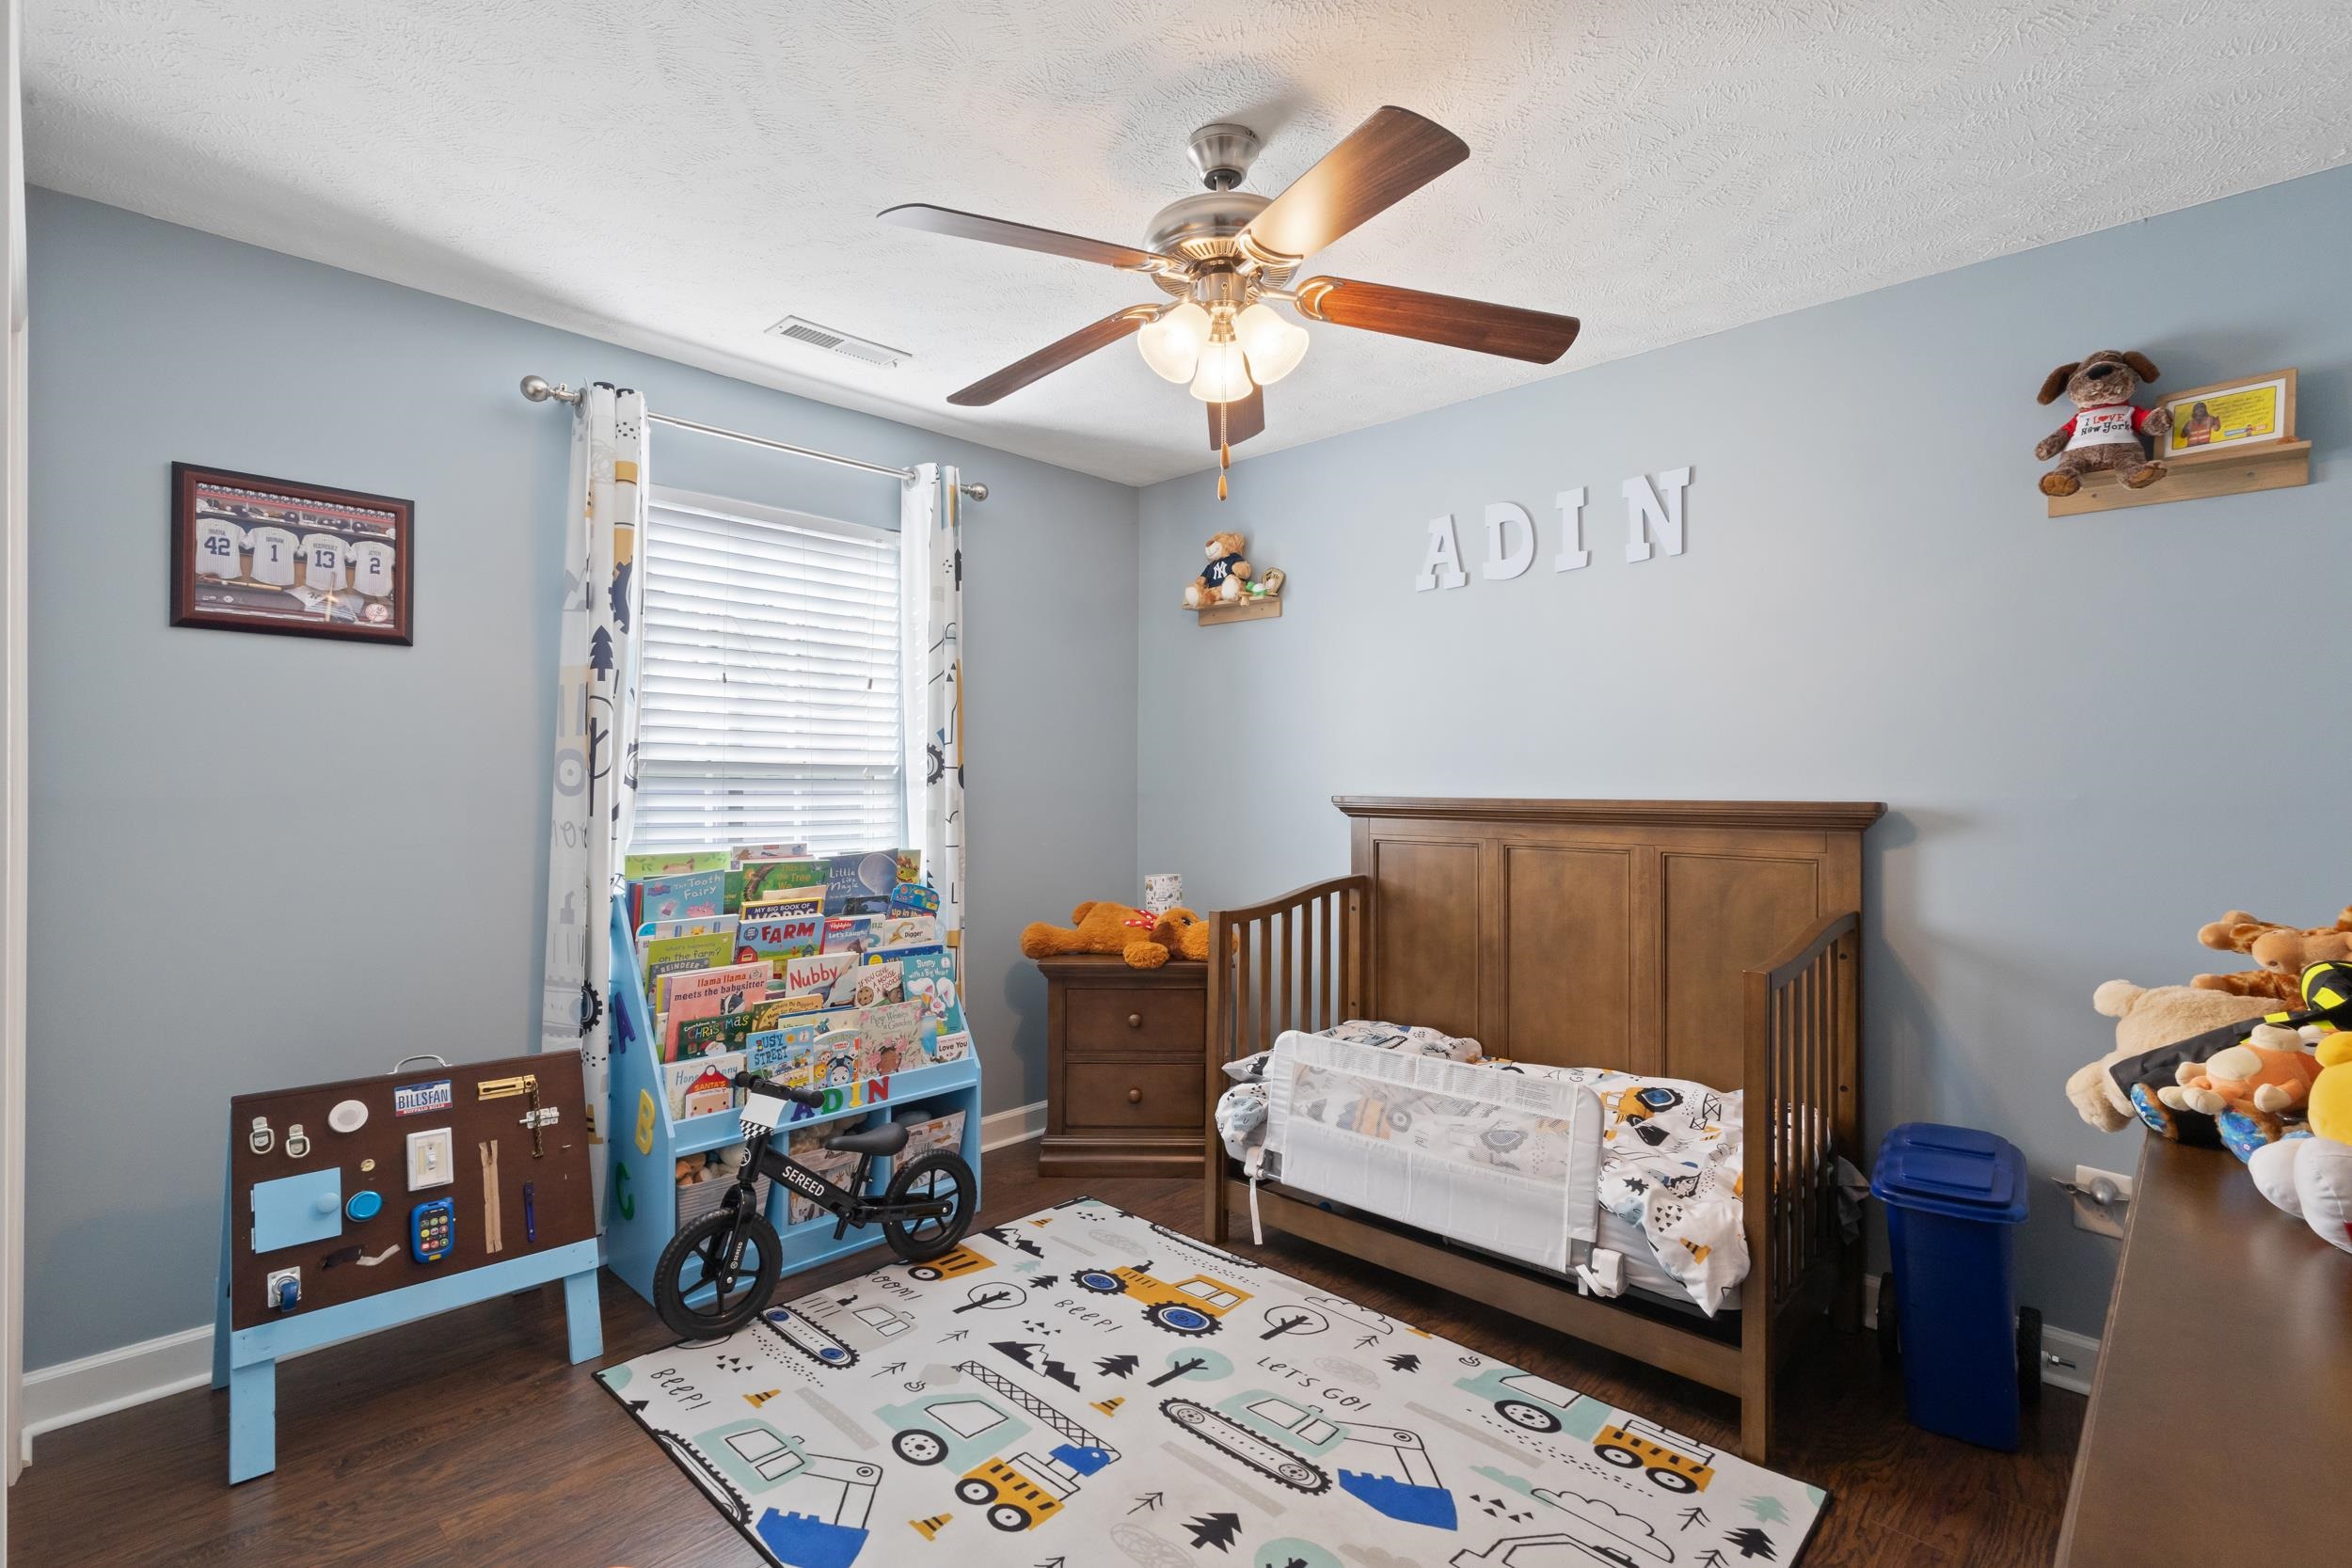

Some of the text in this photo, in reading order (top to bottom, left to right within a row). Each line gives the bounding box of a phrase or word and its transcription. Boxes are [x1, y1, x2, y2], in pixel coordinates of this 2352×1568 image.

[2102, 420, 2132, 434] York
[1415, 465, 1692, 593] ADIN
[204, 535, 230, 557] 42
[270, 544, 278, 562] 1
[314, 549, 336, 569] 13
[369, 557, 381, 575] 2
[687, 873, 722, 888] Tooth
[829, 866, 856, 879] Little
[684, 886, 717, 902] Fairy
[891, 908, 901, 917] Up
[902, 909, 910, 917] in
[761, 922, 816, 944] FARM
[904, 930, 923, 939] Digger
[674, 952, 691, 961] the
[916, 958, 935, 968] Bunny
[660, 961, 701, 974] REINDEER
[789, 962, 838, 990] Nubby
[864, 972, 875, 984] YOU
[875, 965, 889, 977] GIVE
[878, 969, 897, 984] MOUSE
[696, 973, 747, 988] llama llama
[674, 980, 765, 1001] meets the babysitter
[755, 1034, 784, 1053] BUSY
[754, 1045, 788, 1066] STREET
[693, 1080, 726, 1092] SANTA'S
[398, 1088, 449, 1110] BILLSFAN
[782, 1165, 825, 1196] SEREED
